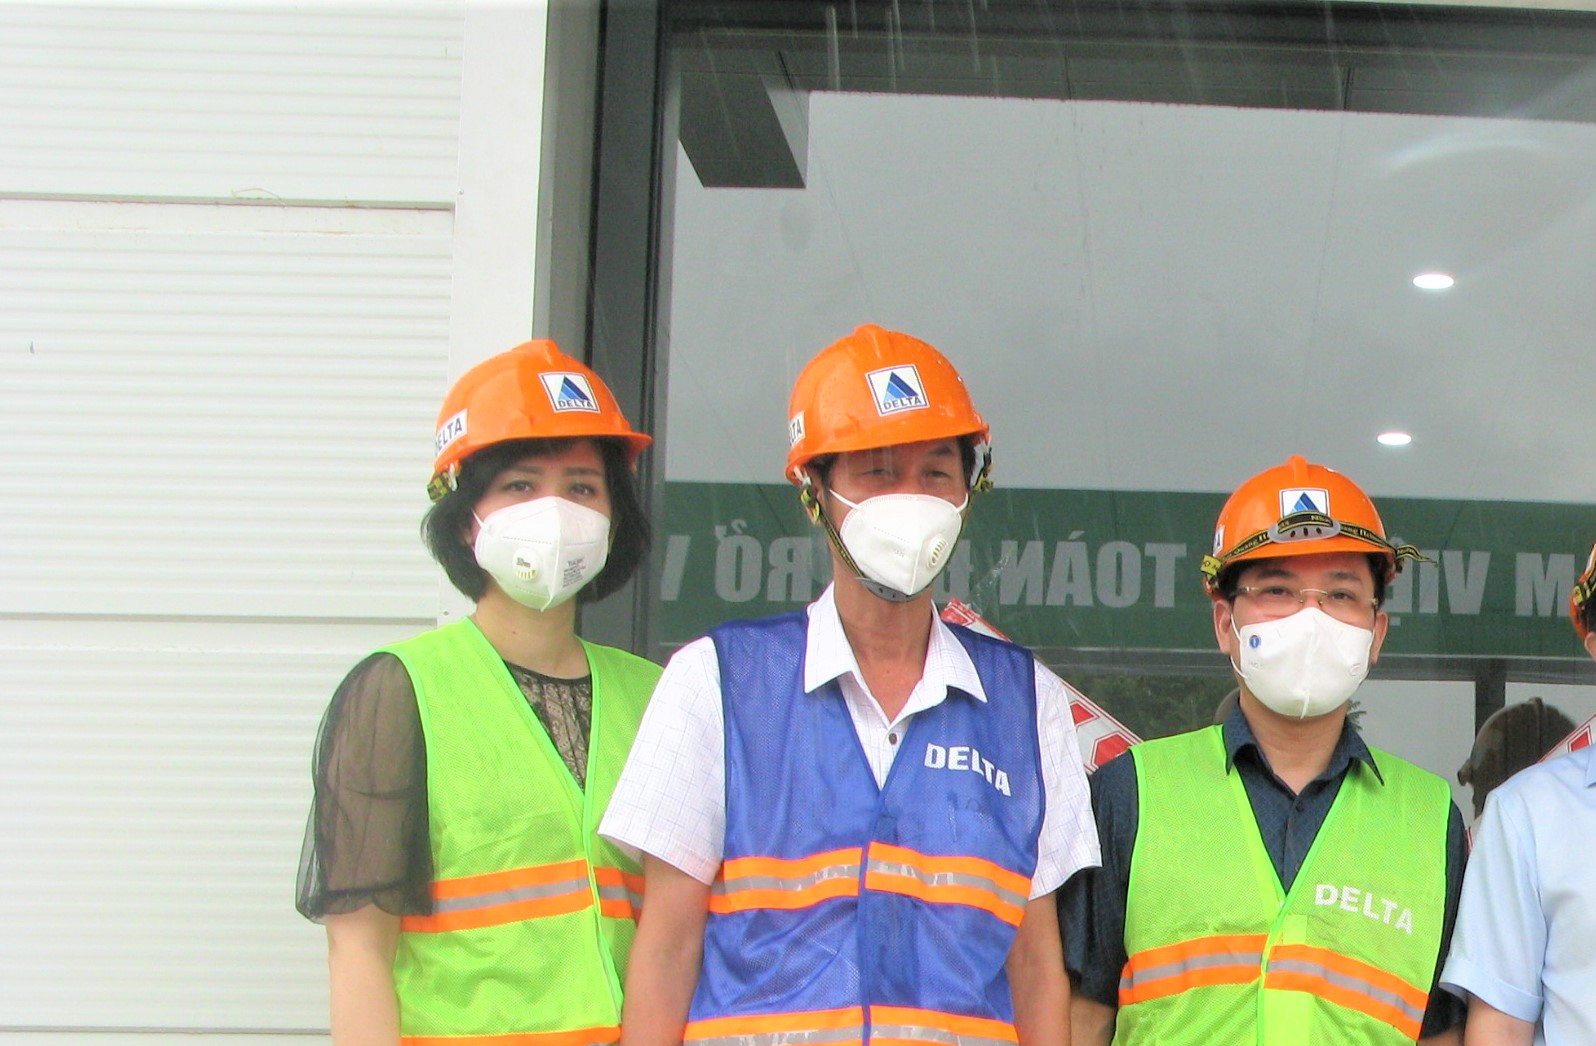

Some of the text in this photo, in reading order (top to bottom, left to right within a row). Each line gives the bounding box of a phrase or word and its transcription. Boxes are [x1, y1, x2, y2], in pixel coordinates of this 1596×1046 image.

[559, 399, 594, 409] DELTA
[883, 396, 922, 410] DELTA
[923, 742, 1012, 797] DELTA
[1315, 883, 1415, 936] DELTA
